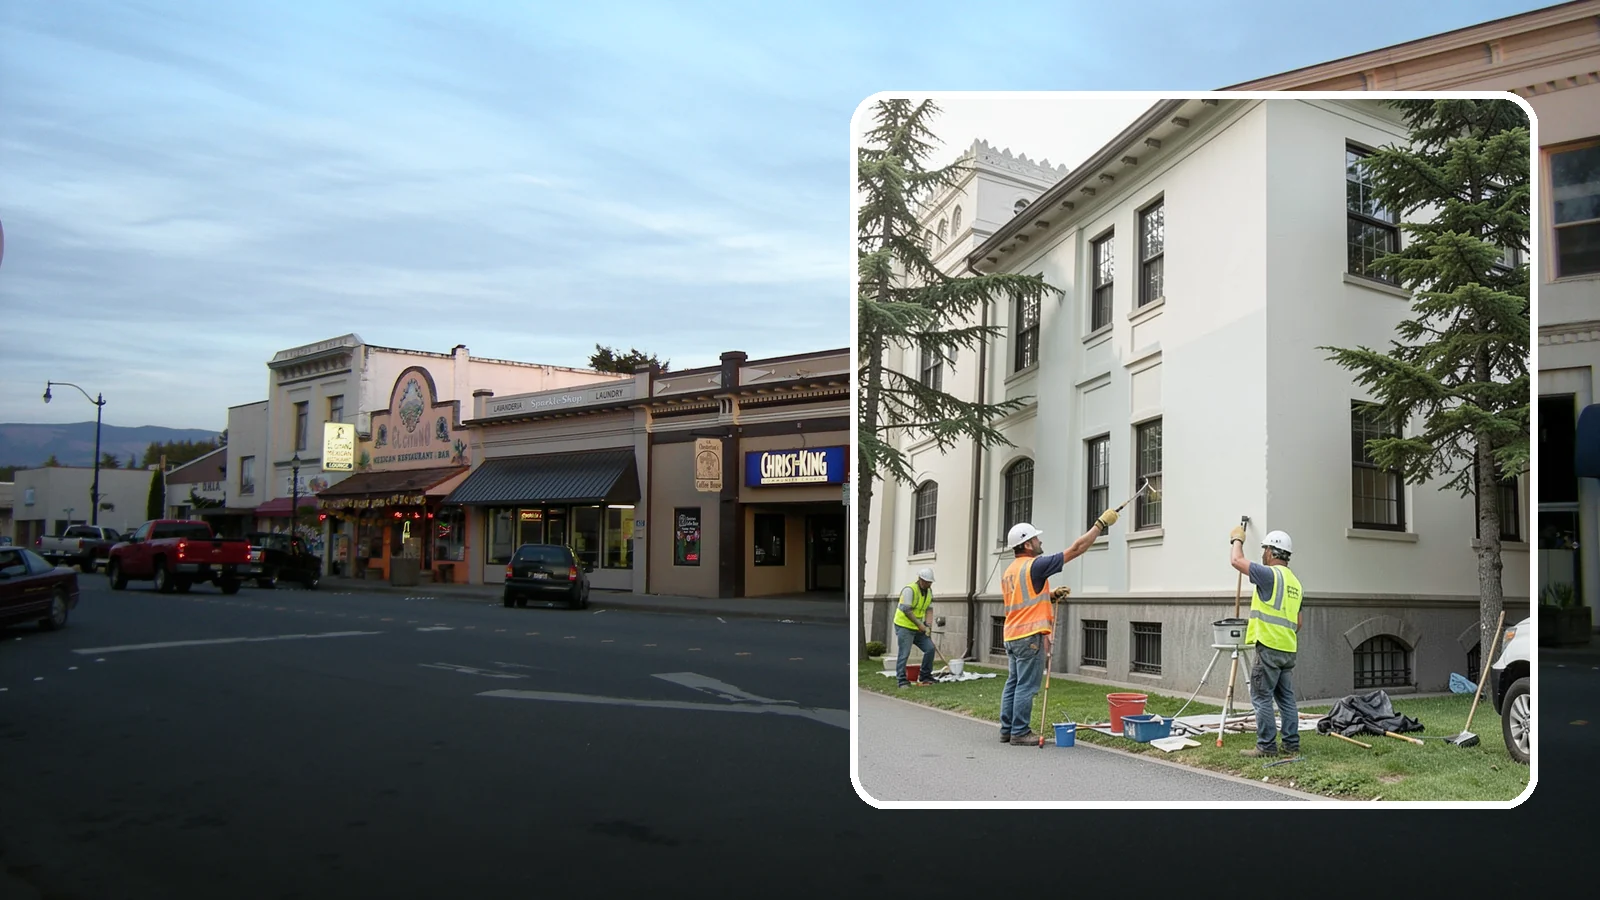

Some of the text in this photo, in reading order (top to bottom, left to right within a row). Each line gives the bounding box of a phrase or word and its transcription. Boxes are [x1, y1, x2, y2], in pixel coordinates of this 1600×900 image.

[595, 389, 624, 400] LAUNDRY
[493, 402, 523, 413] LAVANDERIA
[531, 395, 582, 410] Sparkle Shop
[373, 455, 396, 465] MEXICAN
[397, 451, 433, 462] RESTAURANT
[437, 450, 450, 459] BAR
[761, 450, 827, 478] CHRIST KING
